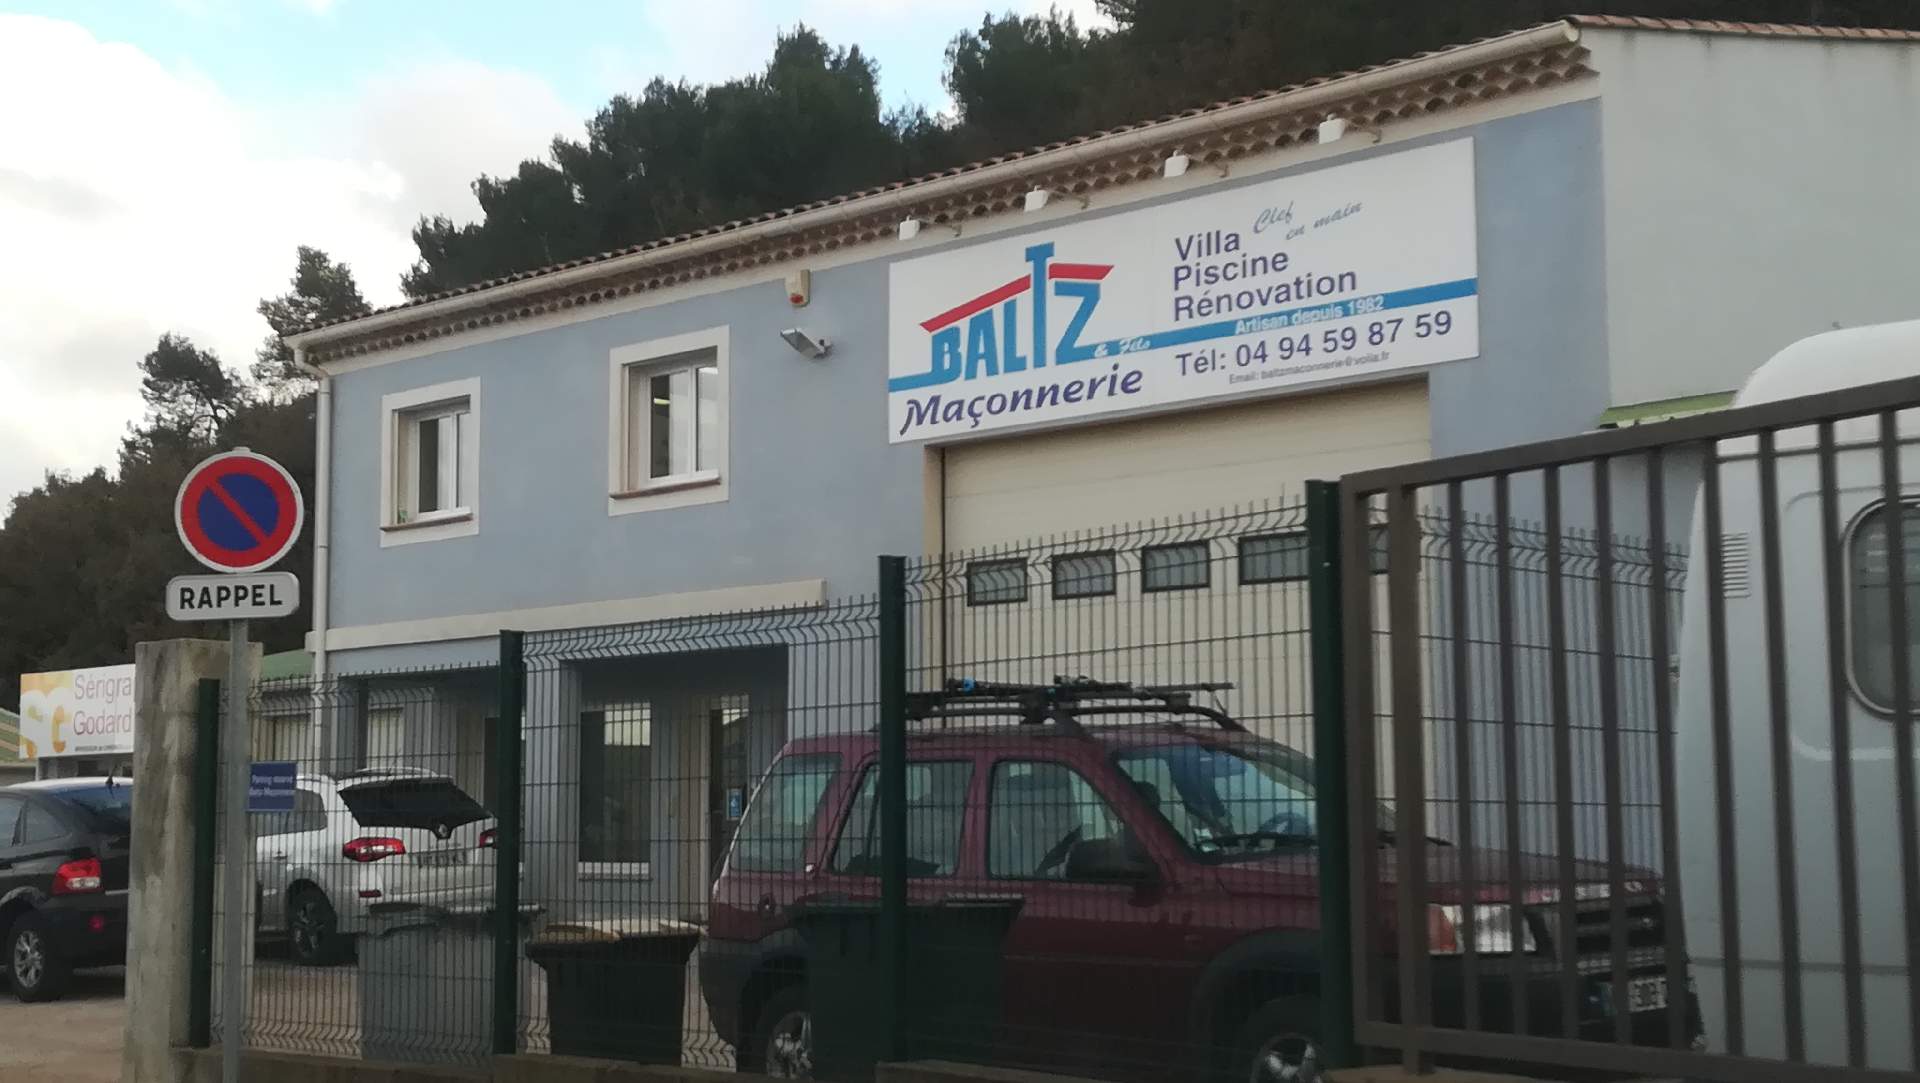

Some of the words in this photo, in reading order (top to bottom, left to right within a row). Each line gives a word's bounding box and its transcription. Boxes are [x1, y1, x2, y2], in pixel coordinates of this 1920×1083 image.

[1253, 201, 1294, 234] Clef
[1313, 202, 1362, 229] main
[1175, 230, 1241, 261] Villa
[1174, 252, 1289, 290] Piscine
[931, 242, 1101, 382] BALTZ
[1174, 271, 1357, 321] Rénovation
[1235, 313, 1289, 335] Artisan
[1292, 303, 1344, 326] depuis
[1348, 295, 1385, 315] 1982
[1175, 349, 1226, 376] Tél:
[1236, 340, 1268, 367] 04
[1279, 333, 1312, 360] 94
[1322, 326, 1357, 353] 59
[1367, 318, 1403, 346] 87
[1415, 310, 1452, 338] 59
[900, 363, 1143, 436] Maçonnerie
[179, 584, 283, 609] RAPPEL
[73, 707, 132, 736] Godard
